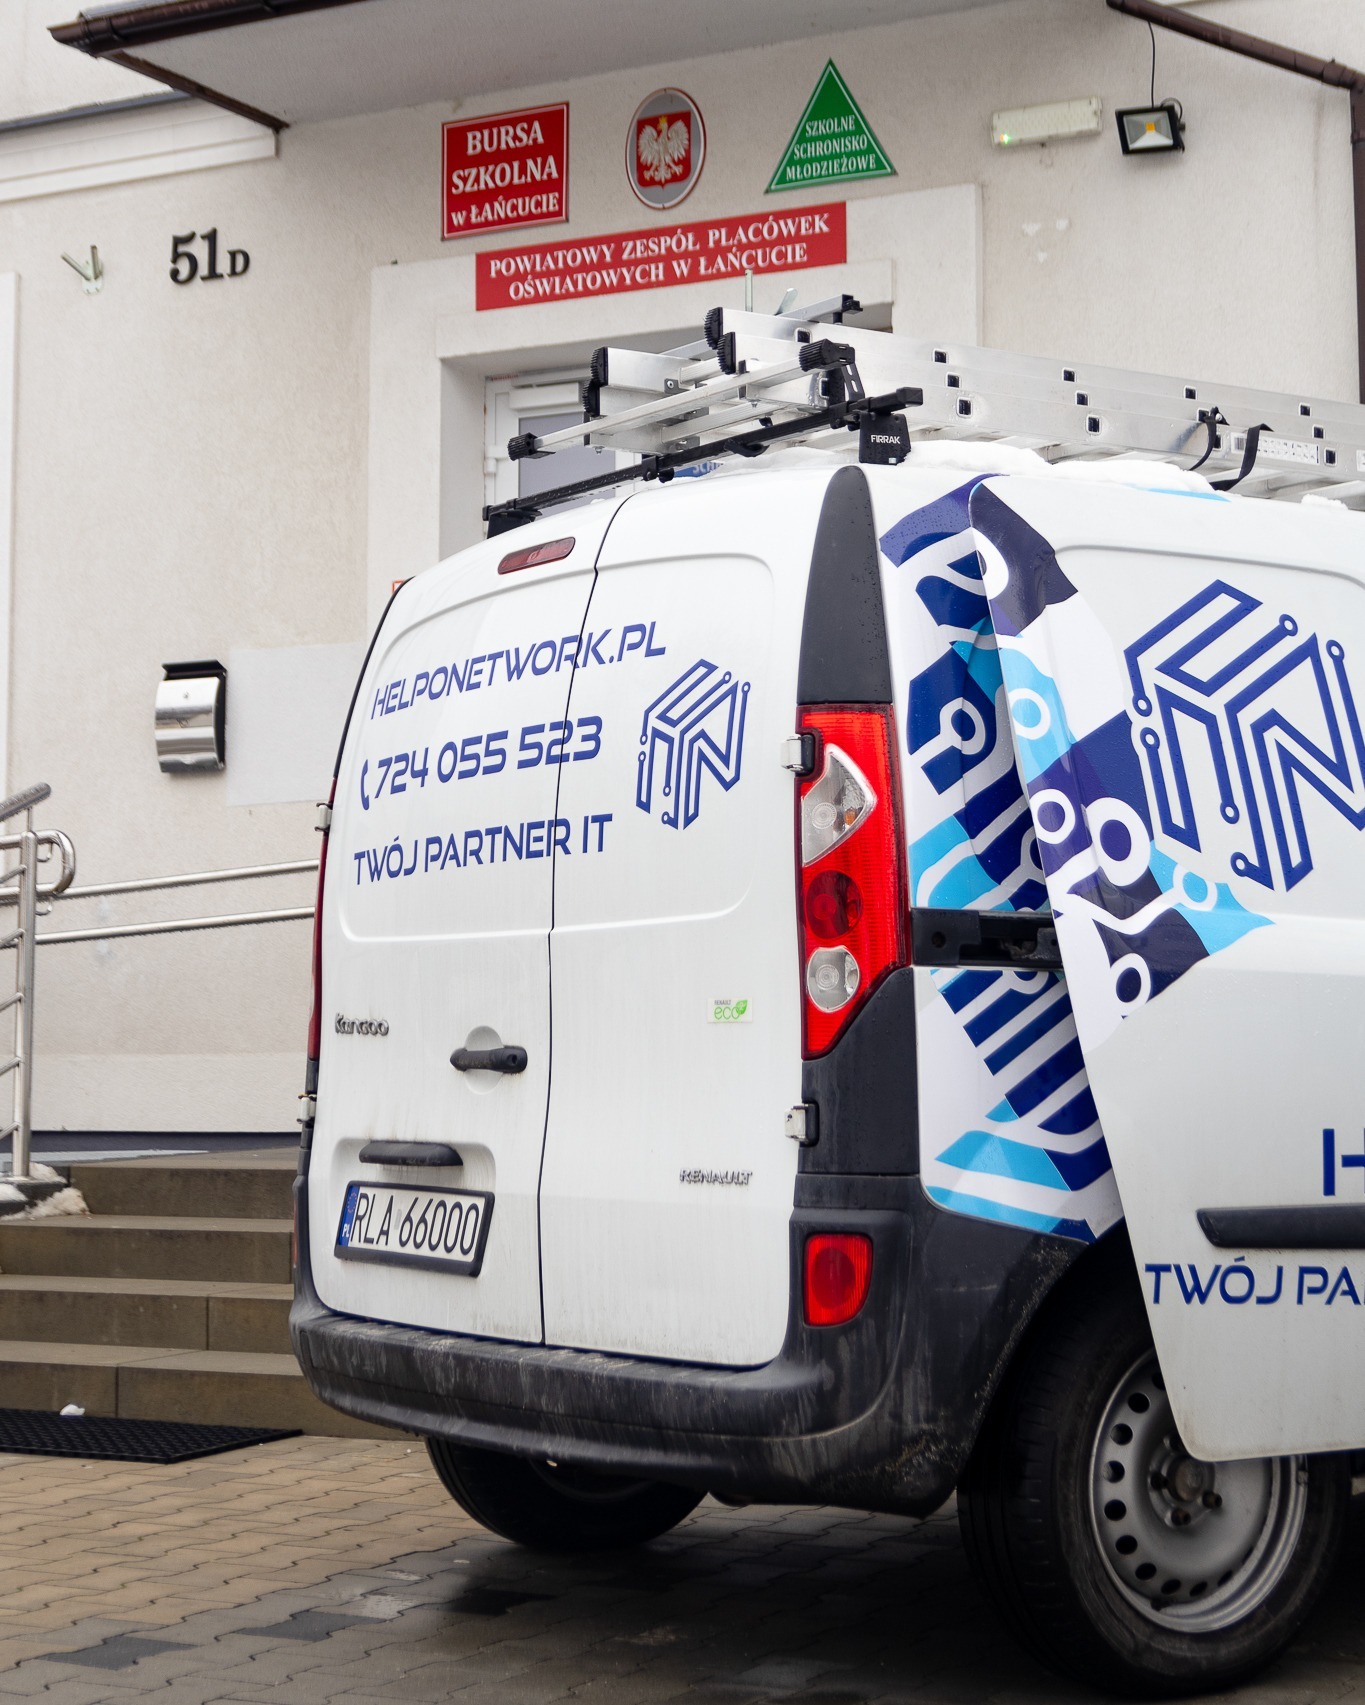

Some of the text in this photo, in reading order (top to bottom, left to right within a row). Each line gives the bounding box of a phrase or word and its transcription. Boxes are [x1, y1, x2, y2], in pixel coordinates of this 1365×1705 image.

[466, 120, 544, 156] BURSA
[805, 115, 855, 137] SZKOLNE
[793, 134, 867, 160] SCHRONISKO
[451, 155, 559, 195] SZKOLNA
[786, 154, 876, 181] MŁODZIEŻOWE
[470, 192, 559, 224] ŁAŃCUCIE
[489, 214, 830, 278] POWIATOWY ZESPÓŁ PLACÓWEK
[509, 243, 808, 300] OŚWIATOWYCH W ŁAŃCUCIE
[870, 434, 901, 445] FIRRAK
[371, 621, 667, 720] HELPONETWORK.PL
[374, 715, 603, 798] 724 055 523
[353, 813, 613, 885] TWÓJ PARTNER IT
[713, 1006, 740, 1020] eco
[680, 1168, 753, 1186] RENAULT
[342, 1193, 480, 1256] PL RLA 66000
[1144, 1256, 1365, 1305] TWÓJ PA
